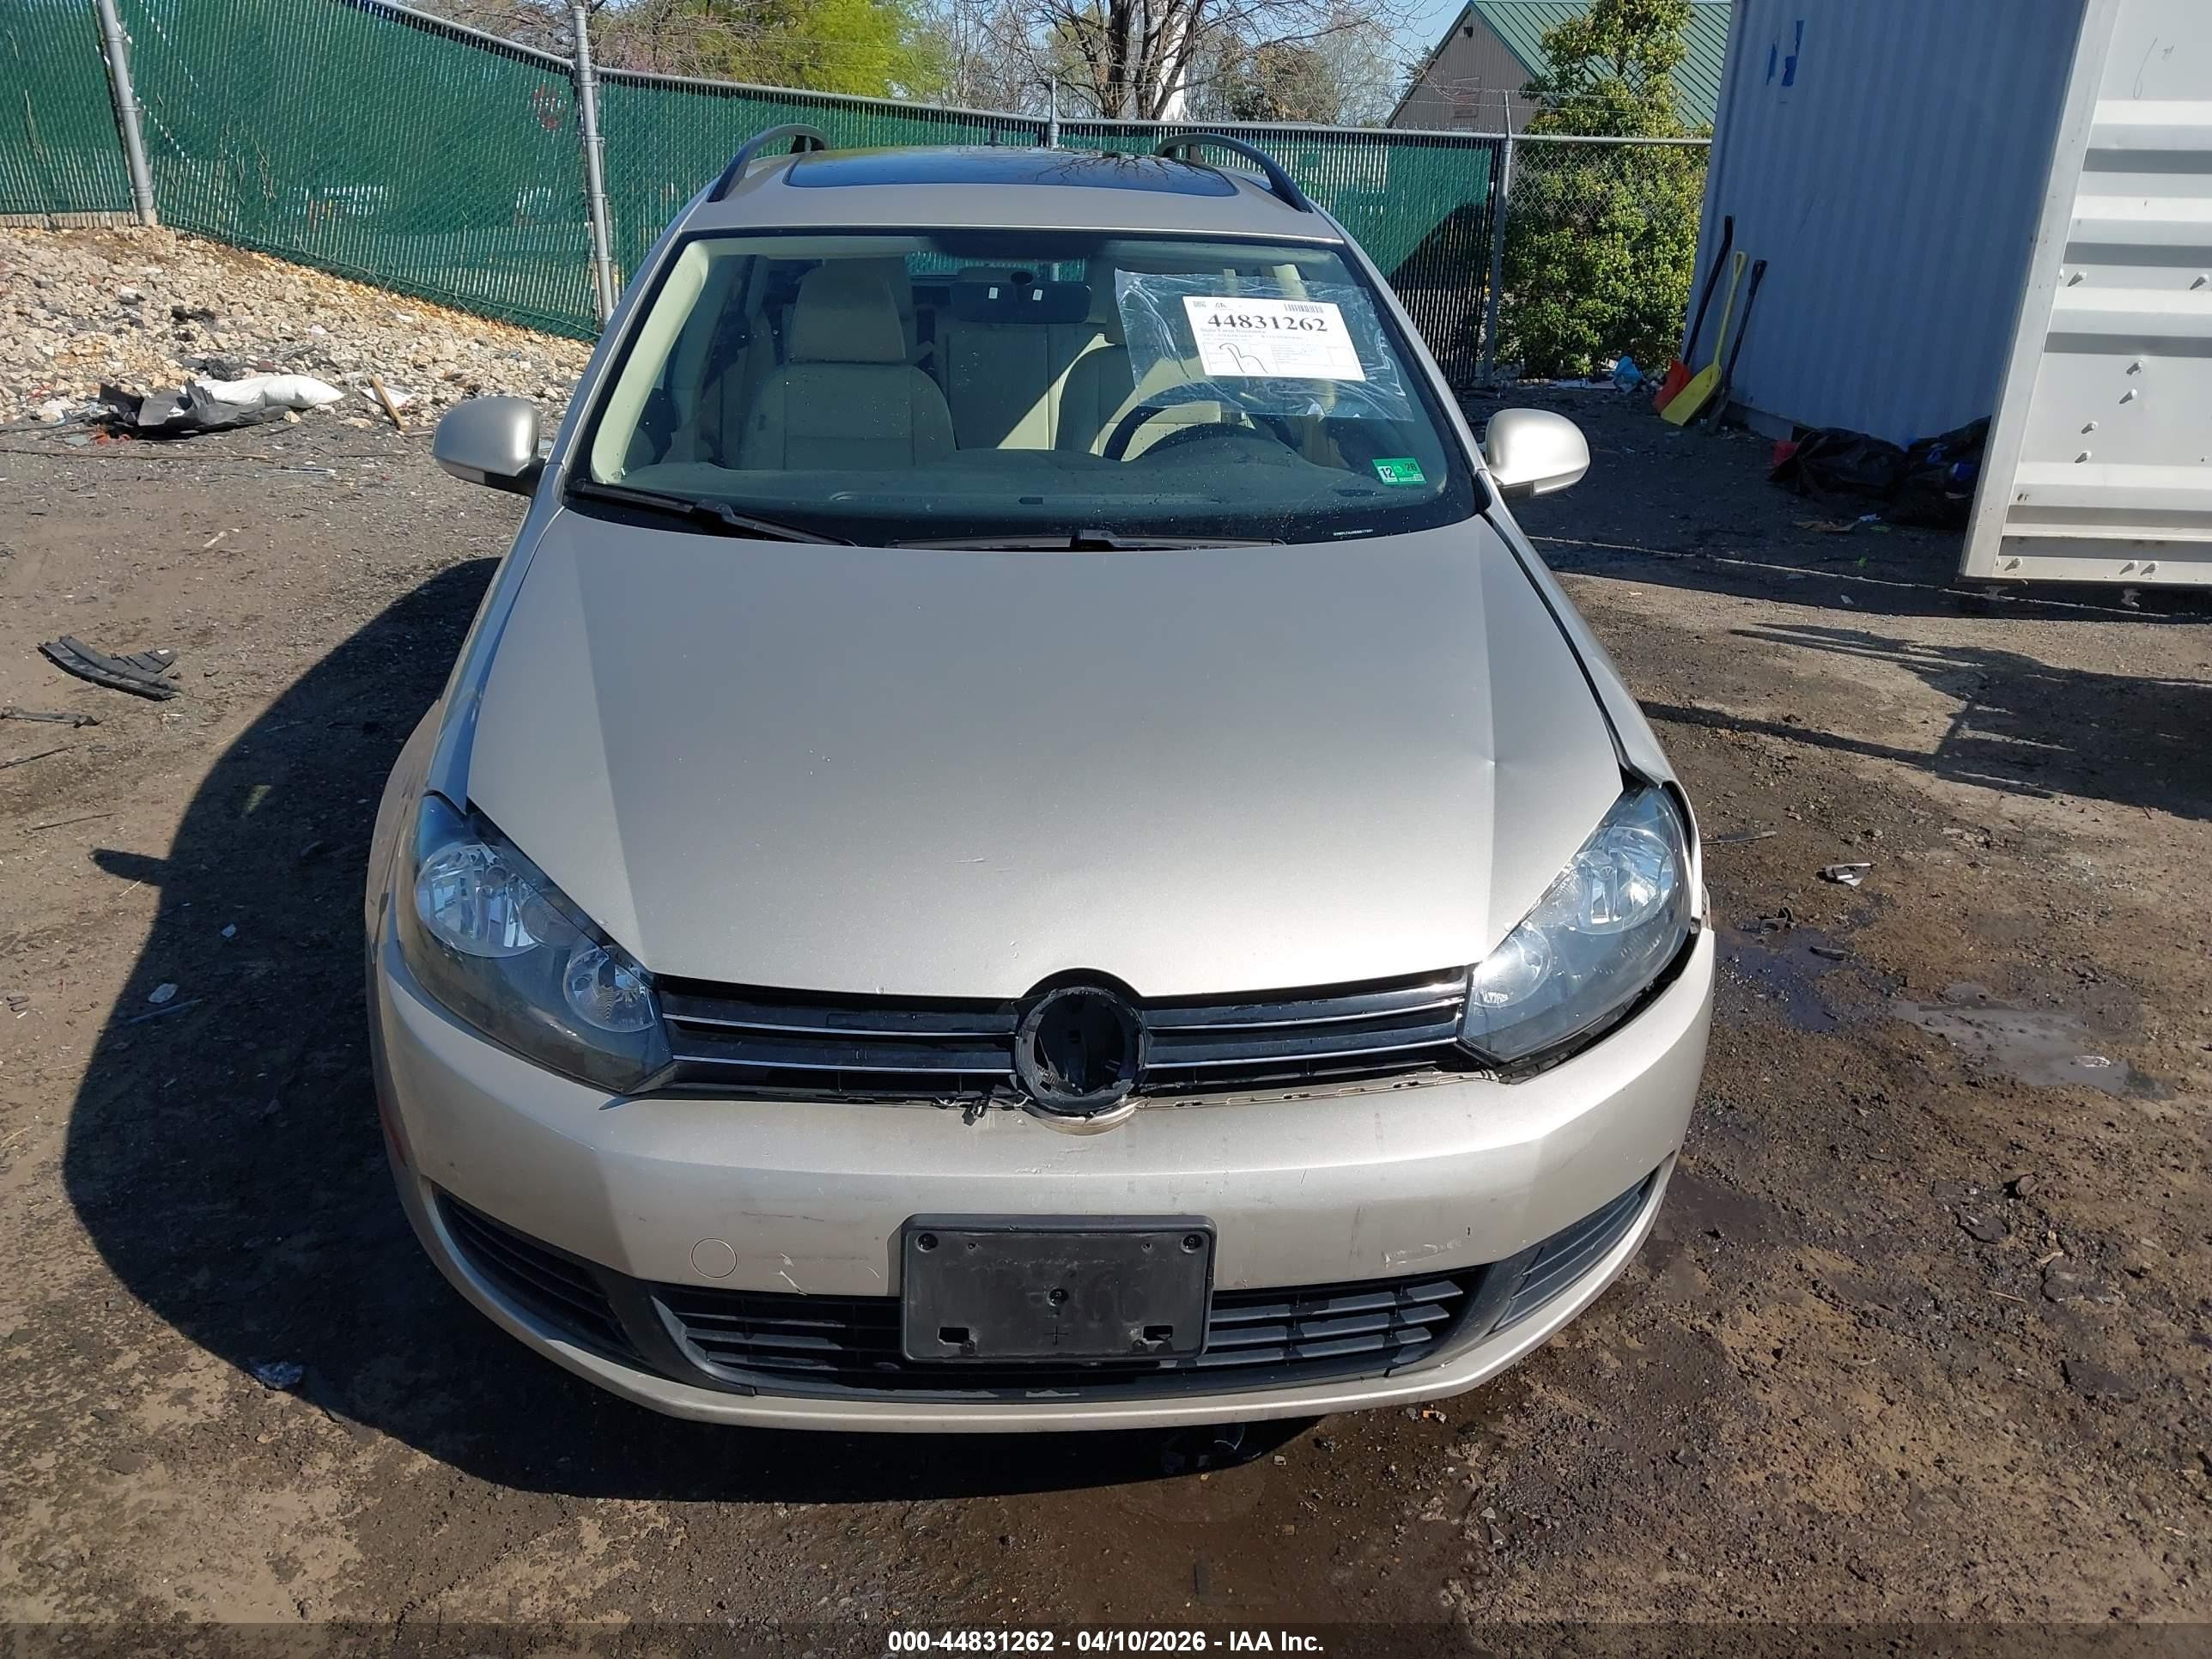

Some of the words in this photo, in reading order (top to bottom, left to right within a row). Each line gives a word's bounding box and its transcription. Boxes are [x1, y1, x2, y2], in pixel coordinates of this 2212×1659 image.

[1207, 313, 1328, 332] 44831262
[1404, 462, 1418, 471] 26
[1380, 467, 1395, 478] 12
